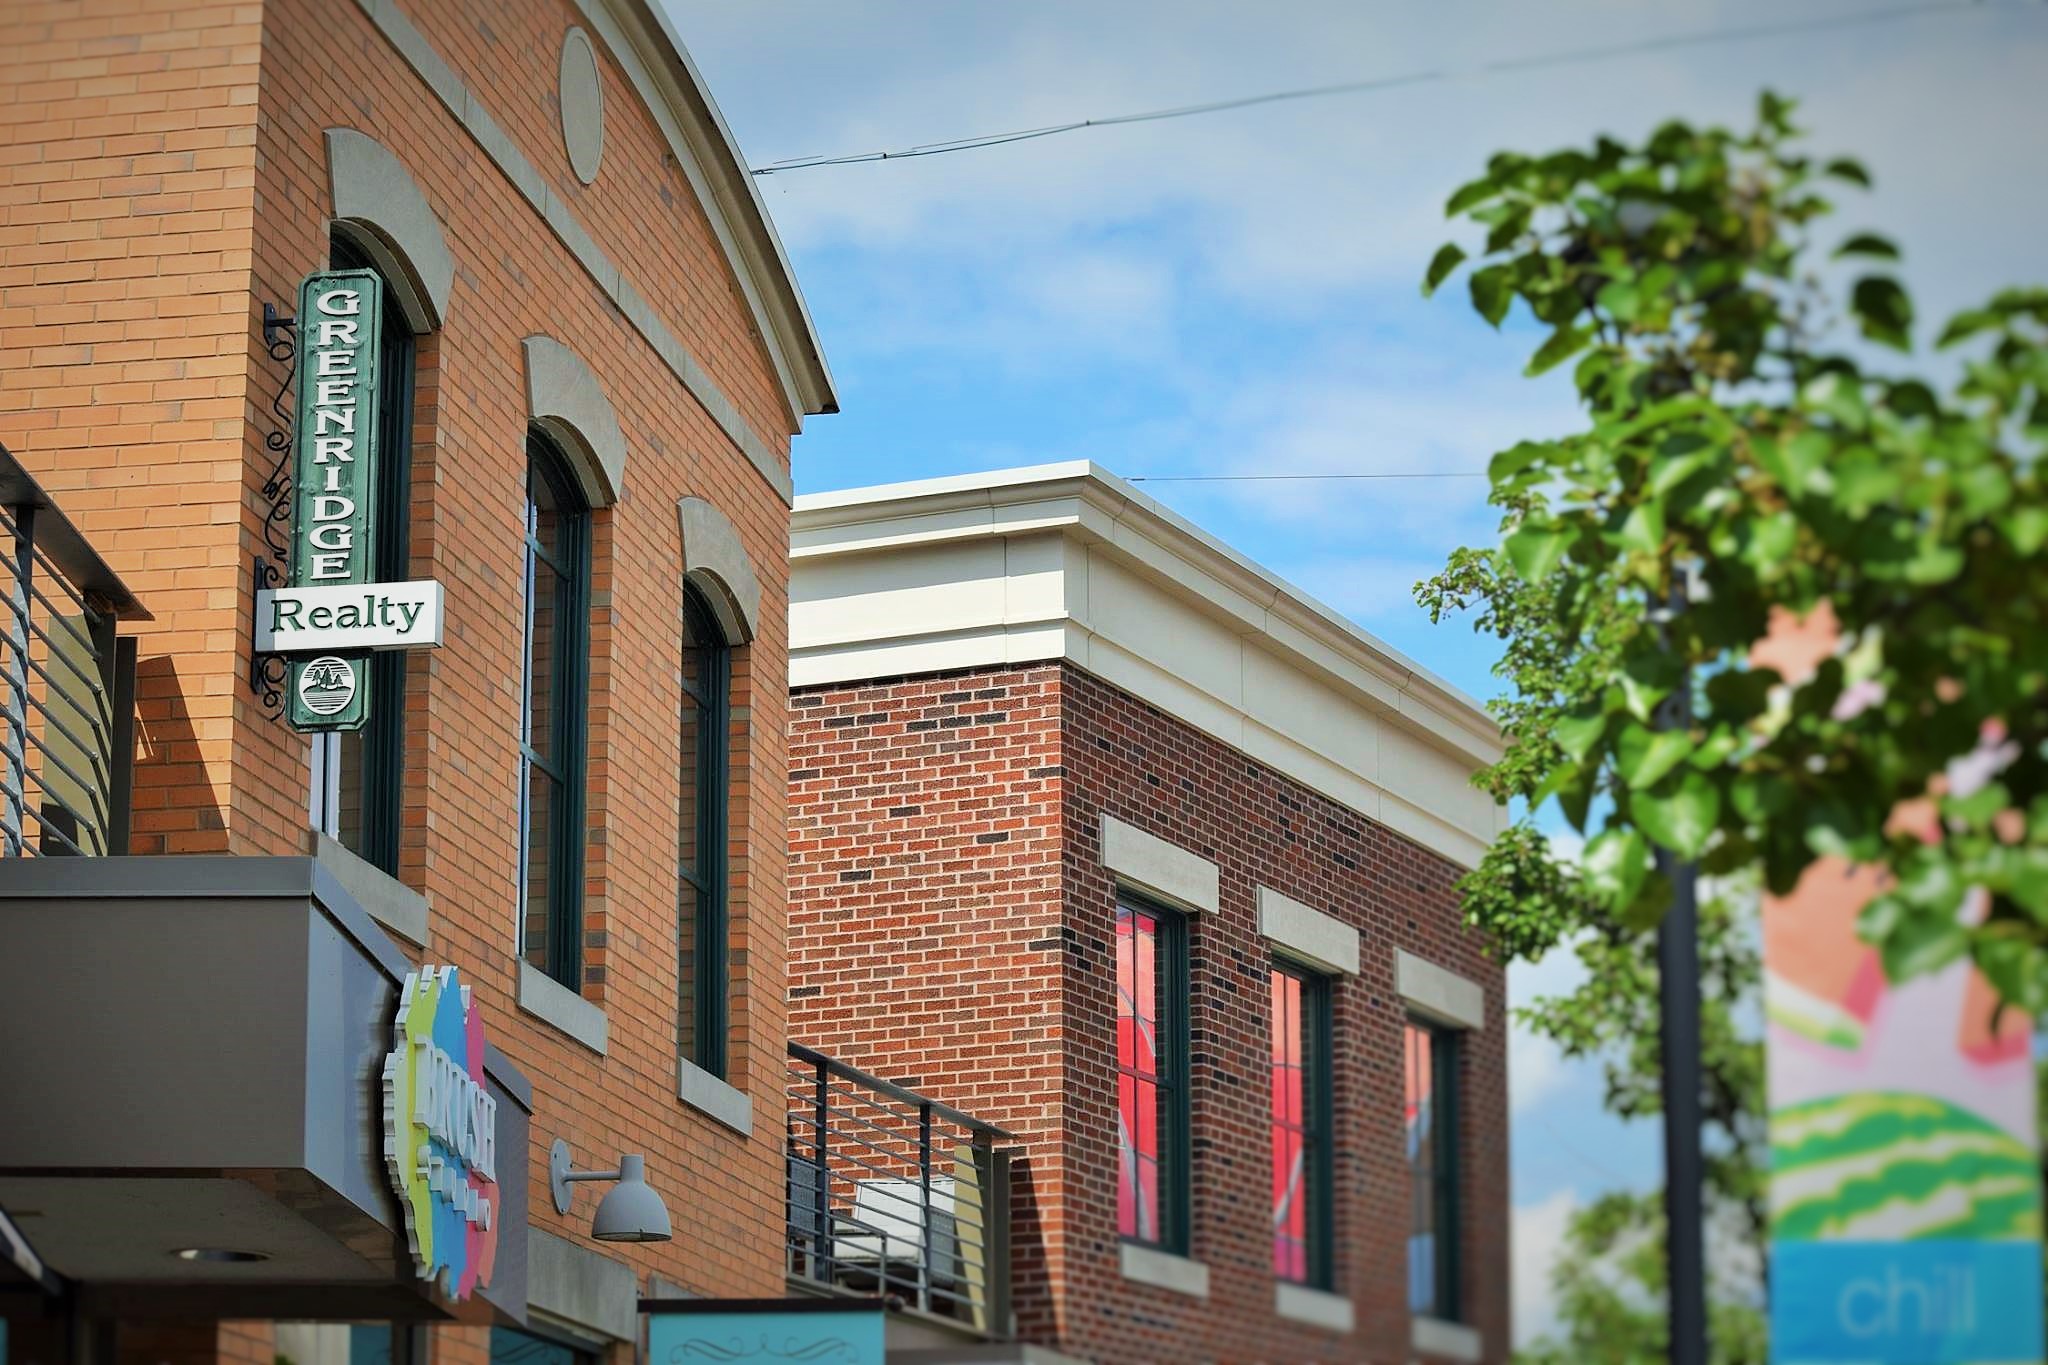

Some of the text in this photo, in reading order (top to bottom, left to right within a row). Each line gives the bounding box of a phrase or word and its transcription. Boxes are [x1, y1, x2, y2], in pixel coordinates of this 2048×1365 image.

[309, 289, 360, 580] GREENRIDGE
[270, 594, 424, 635] Realty
[1838, 1264, 1975, 1337] chill
